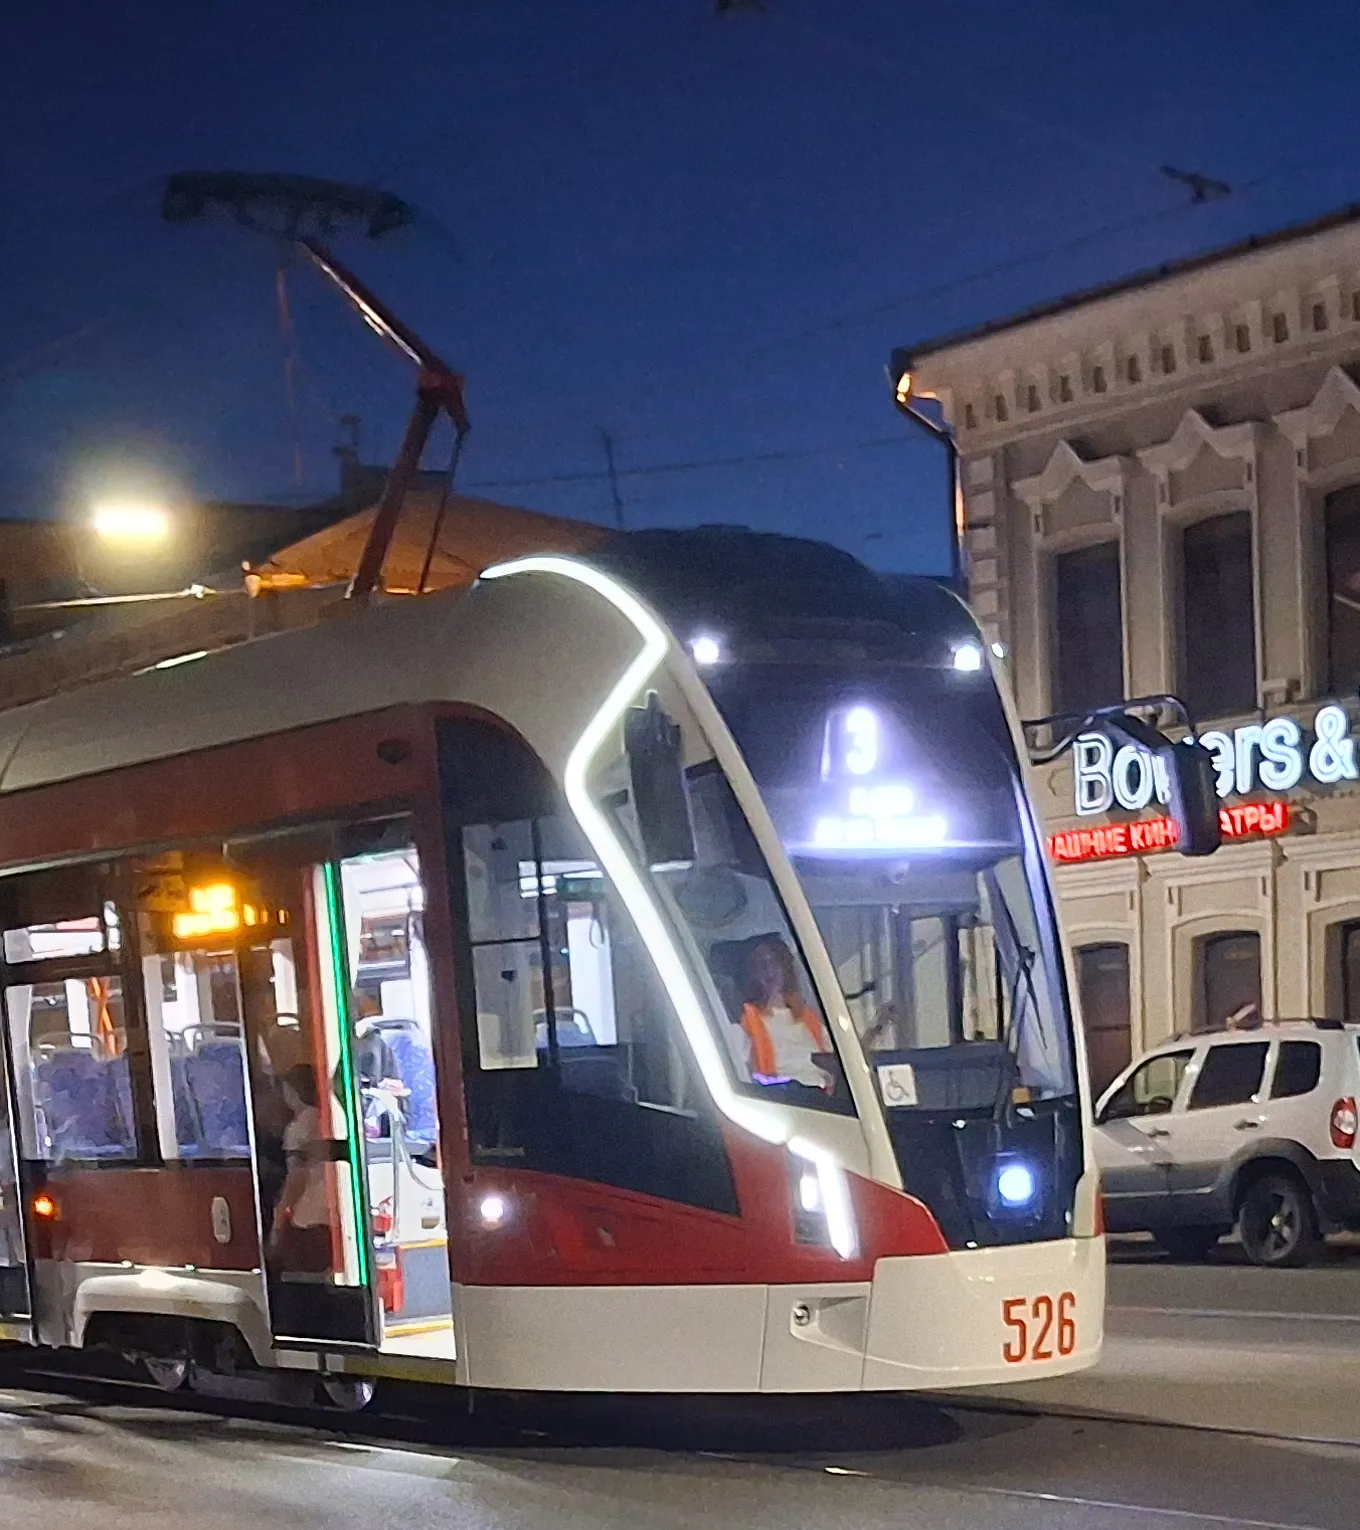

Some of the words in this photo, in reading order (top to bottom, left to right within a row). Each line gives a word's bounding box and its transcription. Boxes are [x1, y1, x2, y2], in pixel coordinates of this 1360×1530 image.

[1074, 717, 1303, 816] Boers
[1309, 705, 1359, 783] &
[1003, 1291, 1076, 1362] 526
